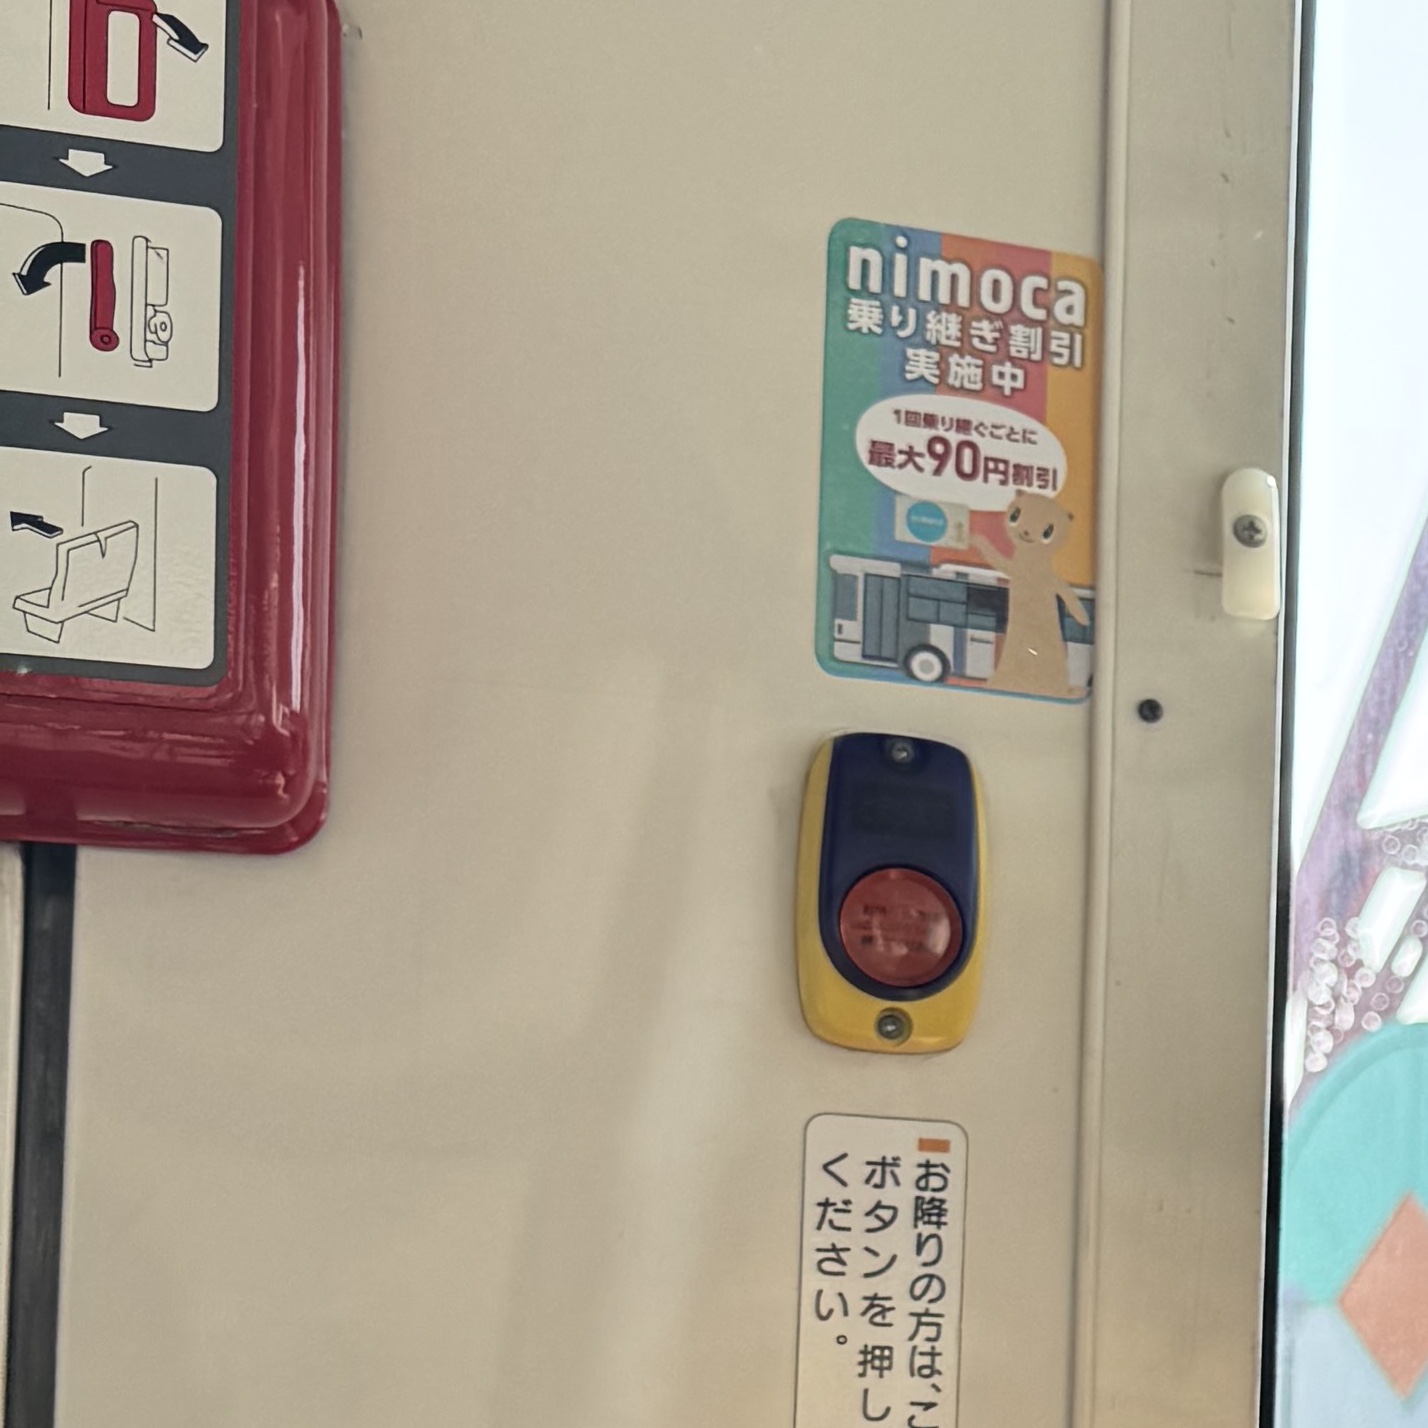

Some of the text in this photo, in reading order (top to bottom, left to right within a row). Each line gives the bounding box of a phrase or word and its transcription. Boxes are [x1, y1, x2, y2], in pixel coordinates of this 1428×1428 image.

[847, 235, 1087, 327] nimoca
[846, 297, 1083, 368] 乗り継ぎ割引
[904, 347, 1025, 396] 実施中
[892, 408, 1038, 445] 1回乗り継ぐごとに
[867, 434, 1058, 492] 最大90円割引
[814, 1152, 853, 1346] ください。
